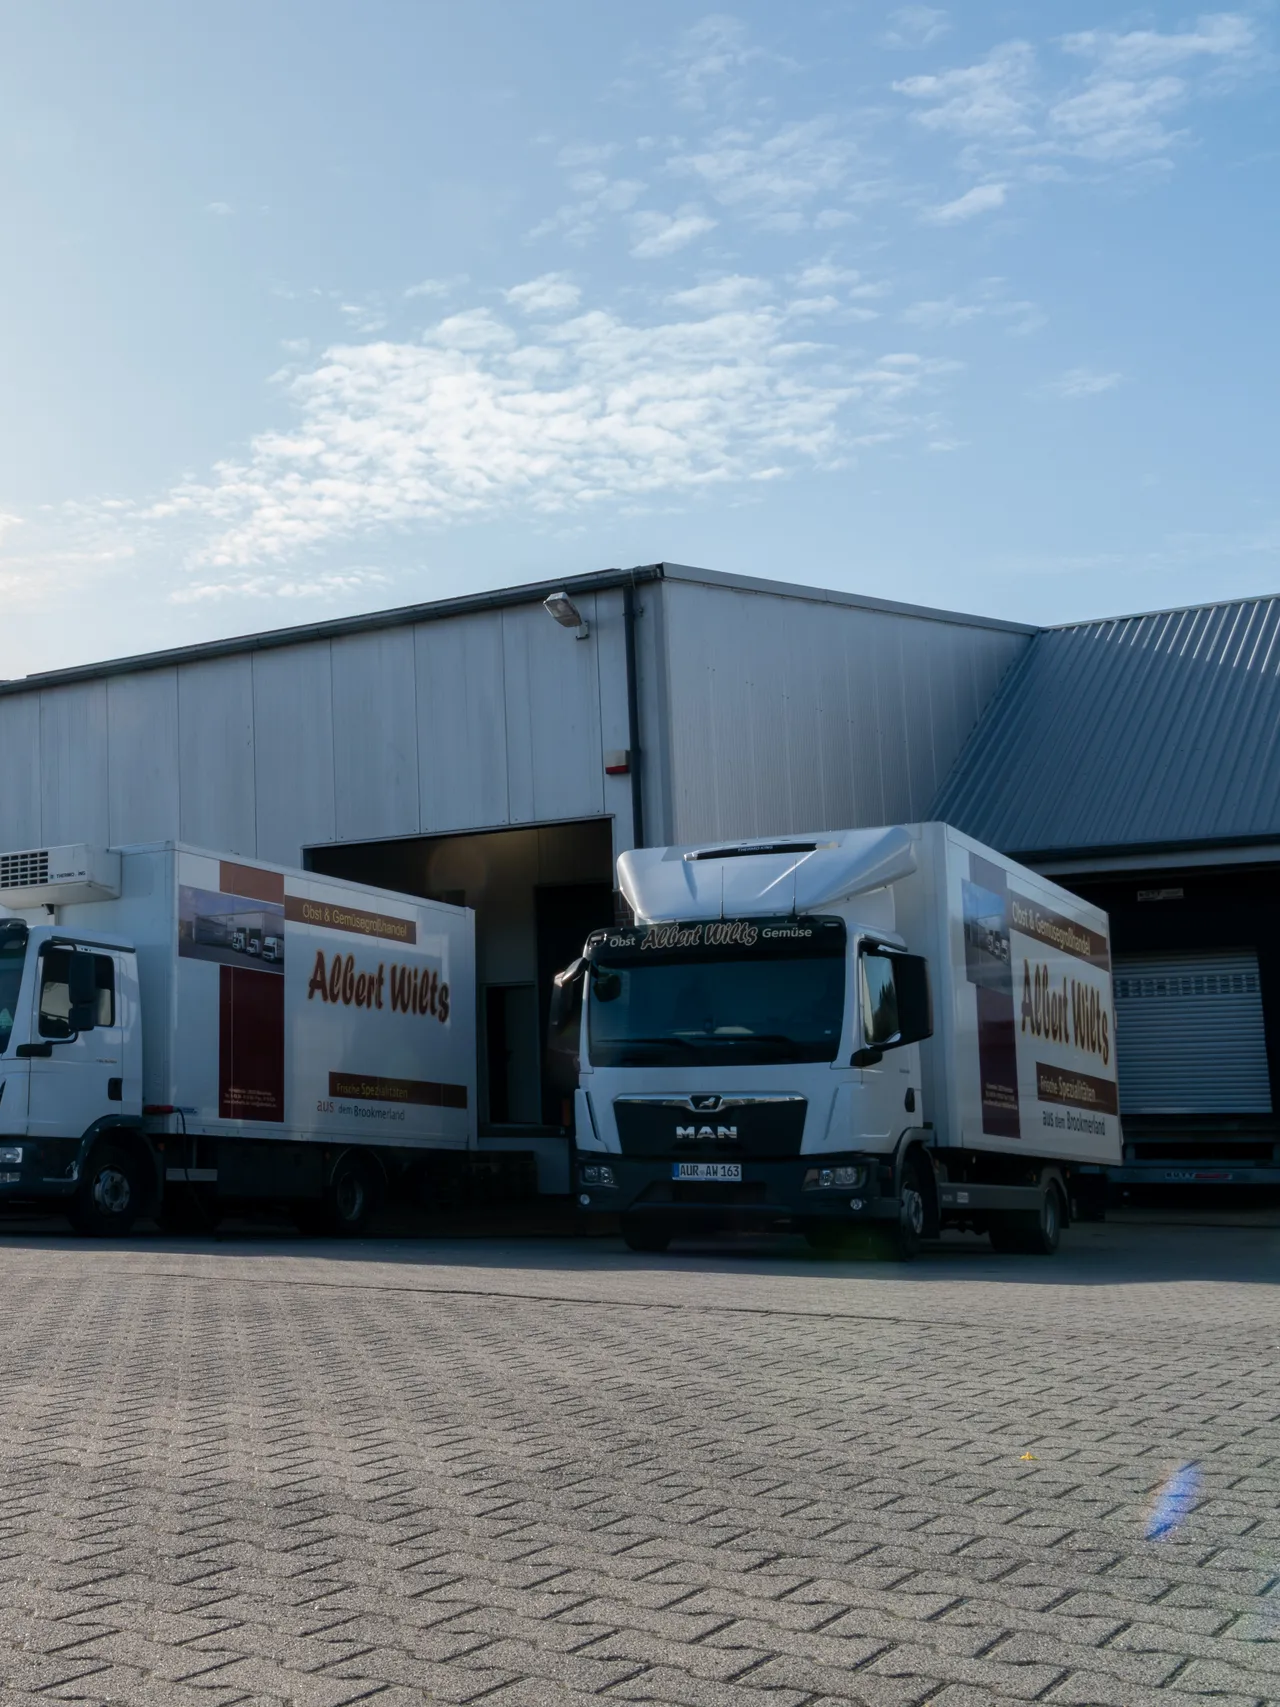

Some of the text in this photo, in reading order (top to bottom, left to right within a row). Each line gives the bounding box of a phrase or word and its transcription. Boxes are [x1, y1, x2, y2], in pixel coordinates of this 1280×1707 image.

[302, 903, 323, 921] Obst
[332, 909, 407, 936] Gemüsegroßhandel
[610, 921, 813, 950] Obst Albert Wilts Gemüse
[307, 948, 450, 1024] Albert Wilts
[1021, 957, 1109, 1066] Albert Wilts
[317, 1100, 335, 1113] aus
[354, 1105, 405, 1121] Brookmerland
[1042, 1110, 1054, 1127] aus
[676, 1126, 737, 1138] MAN
[680, 1165, 739, 1177] AUR AW 163
